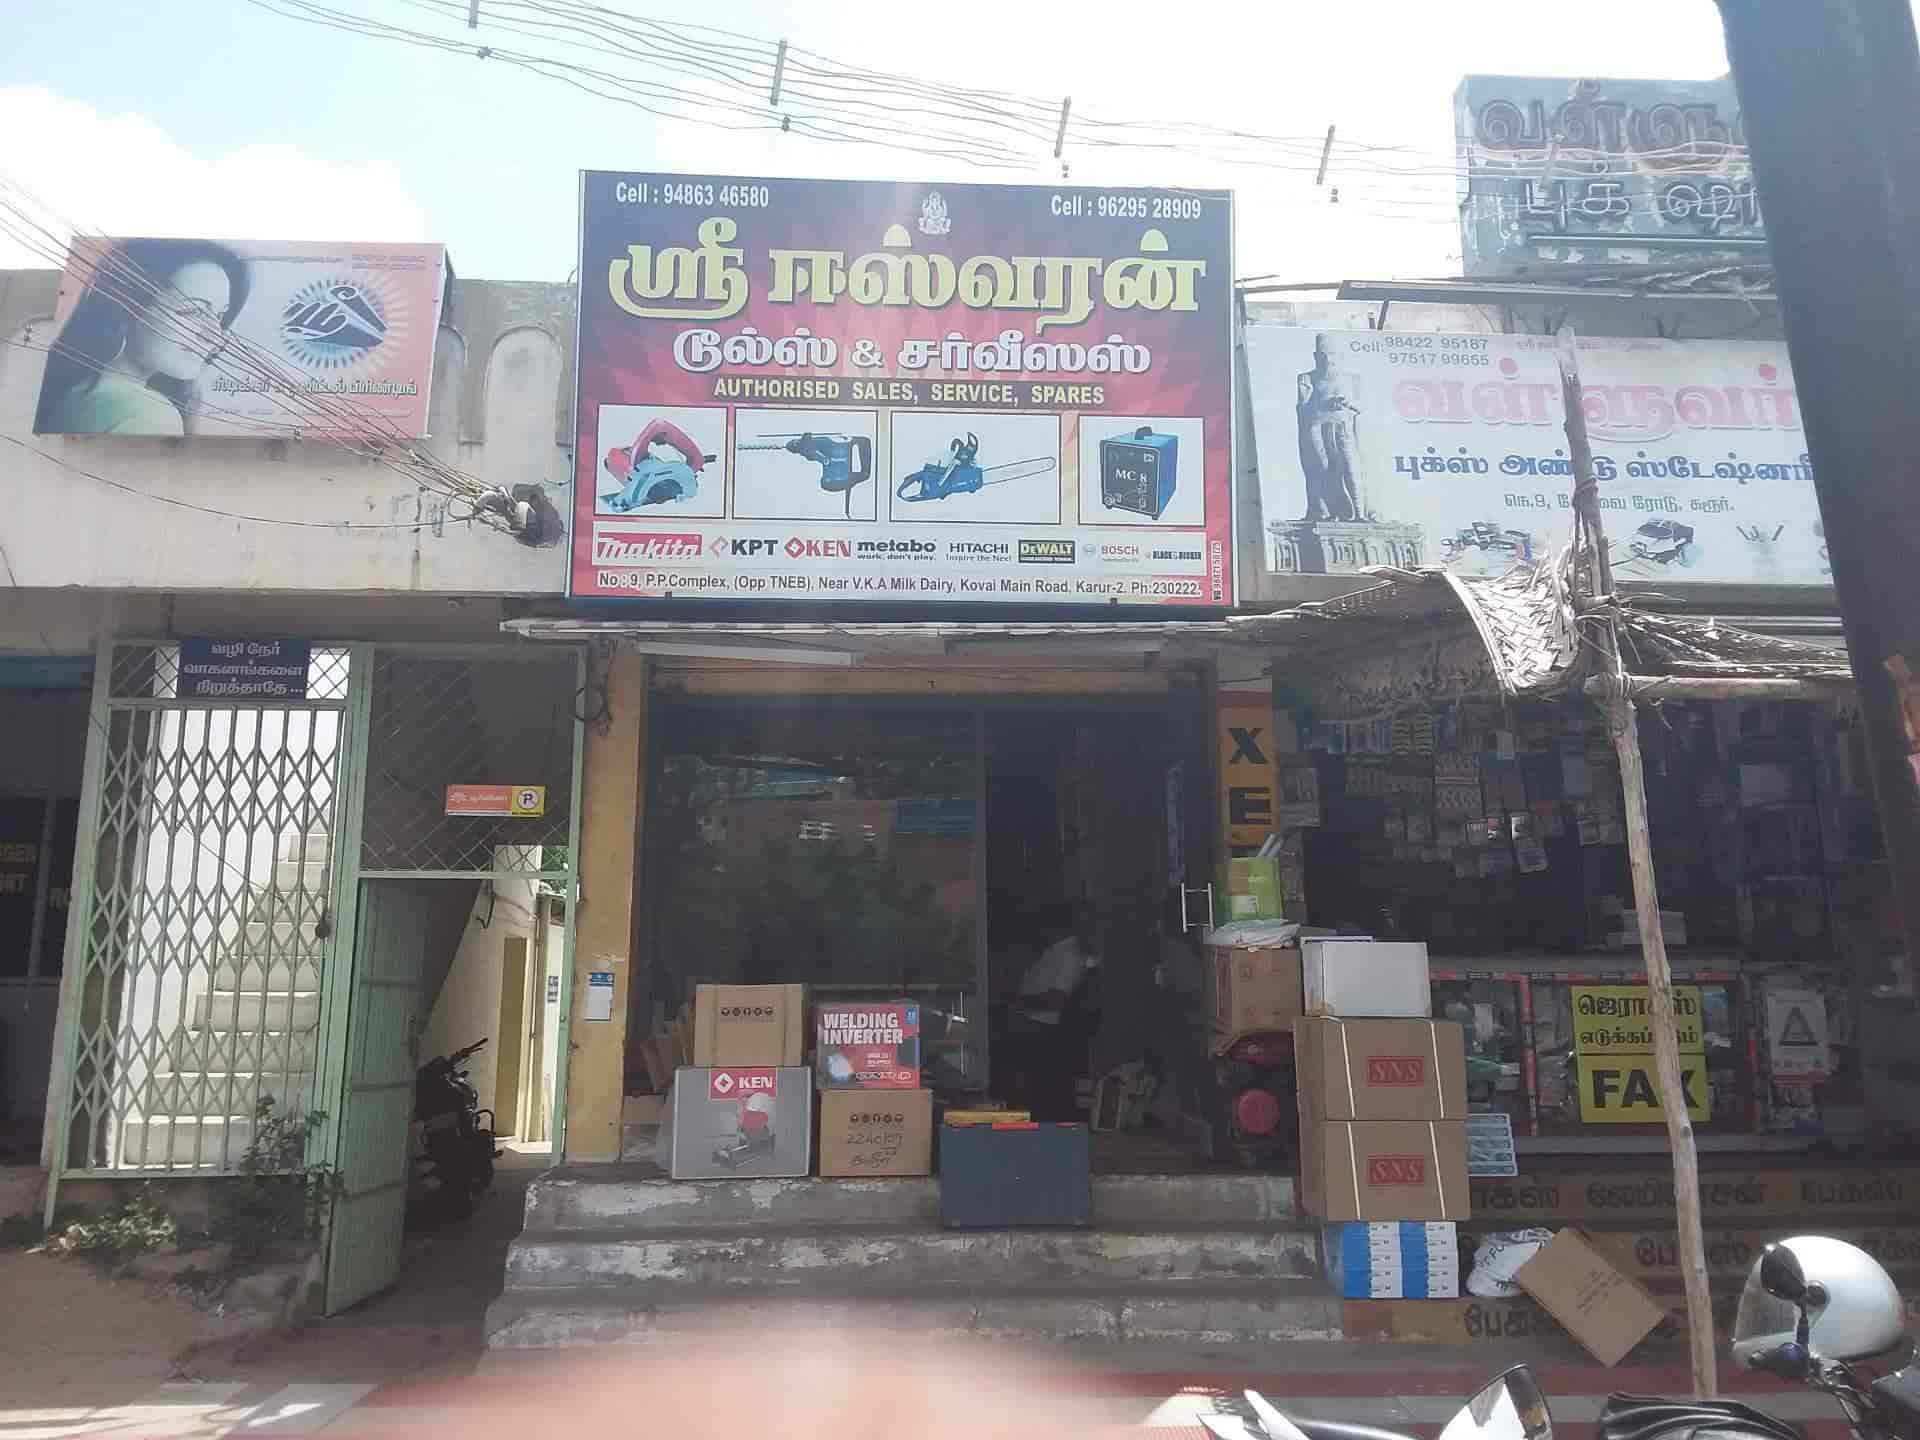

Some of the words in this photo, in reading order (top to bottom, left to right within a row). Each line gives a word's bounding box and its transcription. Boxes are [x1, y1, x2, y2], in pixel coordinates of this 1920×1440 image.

[615, 182, 648, 204] Cell
[663, 183, 714, 206] 94863
[719, 184, 769, 208] 46580
[1051, 194, 1082, 217] Cell
[1097, 196, 1147, 218] 96295
[1151, 197, 1202, 219] 28909
[767, 223, 1206, 336] ஈஸ்வரன்
[673, 327, 838, 373] டூல்ஸ்
[850, 339, 884, 368] &
[896, 328, 1152, 373] சர்வீஸஸ்
[714, 377, 840, 400] AUTHORISED
[852, 381, 919, 405] SALES,
[931, 383, 1019, 407] SERVICE,
[1032, 385, 1105, 405] SPARES
[1395, 446, 1489, 480] புக்ஸ்
[731, 538, 778, 556] KPT
[805, 539, 852, 558] KEN
[857, 539, 937, 552] metabo
[950, 542, 1009, 554] HITACHI
[1101, 544, 1140, 556] BOSCH
[733, 575, 766, 592] (Opp
[818, 577, 849, 590] Near
[890, 577, 916, 591] Milk
[920, 577, 956, 594] Dairy,
[960, 578, 996, 592] Kovai
[1000, 578, 1031, 592] Main
[211, 642, 244, 657] வழி
[1577, 988, 1697, 1018] ஜெராஸ்
[823, 1012, 899, 1030] WELDING
[823, 1028, 904, 1045] INVERTER
[738, 1075, 774, 1090] KEN
[1372, 1064, 1420, 1082] SNS
[1372, 1160, 1420, 1182] SNS
